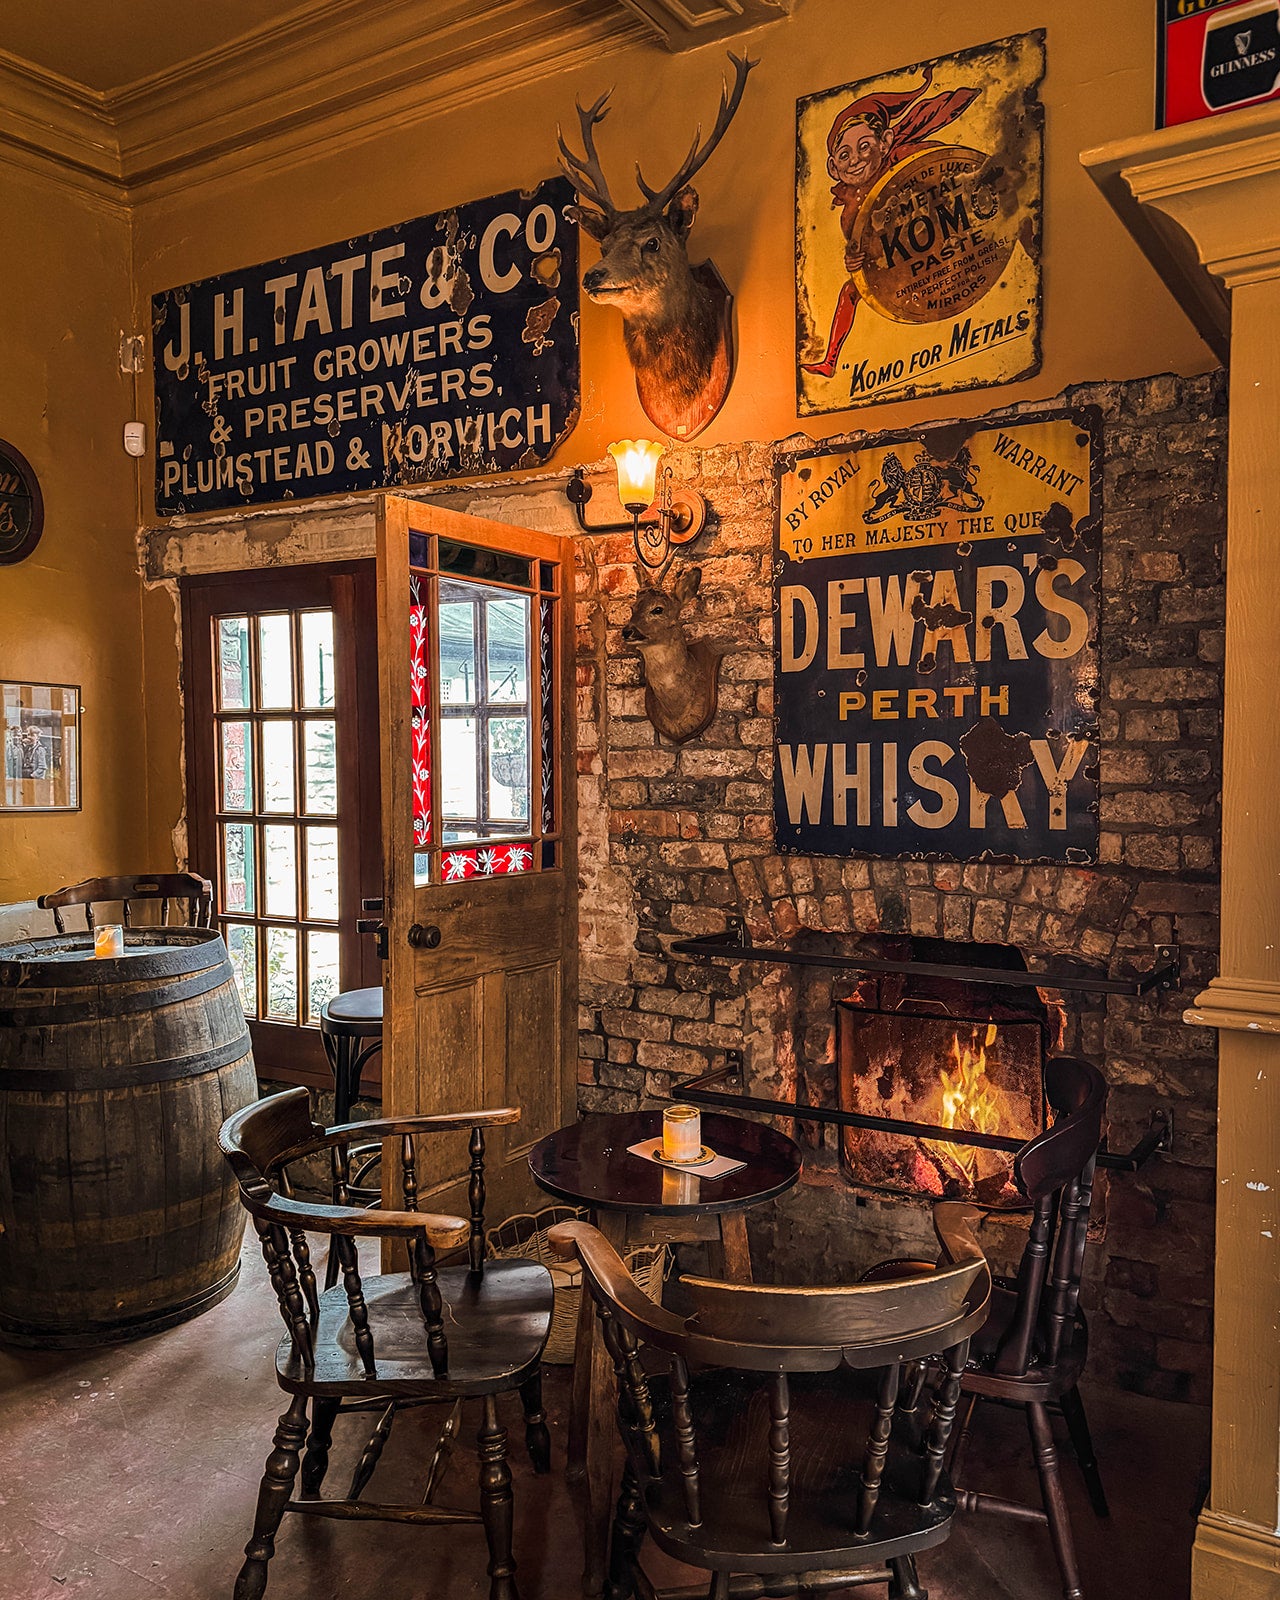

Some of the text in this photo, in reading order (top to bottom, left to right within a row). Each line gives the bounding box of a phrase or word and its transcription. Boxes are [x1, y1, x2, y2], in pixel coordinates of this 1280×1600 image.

[1210, 47, 1276, 78] GUINNESS
[921, 166, 935, 180] DE
[939, 162, 970, 173] LUXE
[899, 177, 962, 217] METAL
[880, 183, 999, 270] KOMO
[895, 275, 931, 298] ENTIRELY
[932, 265, 952, 280] FREE
[953, 253, 976, 270] FROM
[910, 229, 986, 277] PASTE
[264, 242, 407, 347] TATE
[420, 245, 458, 311] &
[912, 254, 999, 301] A PERFECT POLISH
[927, 274, 986, 310] MIRRORS
[940, 278, 970, 297] ALSO FOR
[313, 314, 493, 382] GROWERS
[909, 344, 943, 374] FOR
[208, 356, 297, 404] FRUIT
[209, 415, 233, 444] &
[164, 440, 335, 498] PLUMSTEAD
[346, 436, 371, 471] &
[992, 432, 1085, 497] WARRANT
[784, 502, 809, 532] BY
[808, 458, 861, 510] ROYAL
[792, 537, 813, 554] TO
[821, 533, 856, 552] HER
[865, 521, 949, 546] MAJESTY
[956, 516, 994, 536] THE
[780, 553, 1090, 673] DEWAR'S
[838, 685, 1010, 721] PERTH
